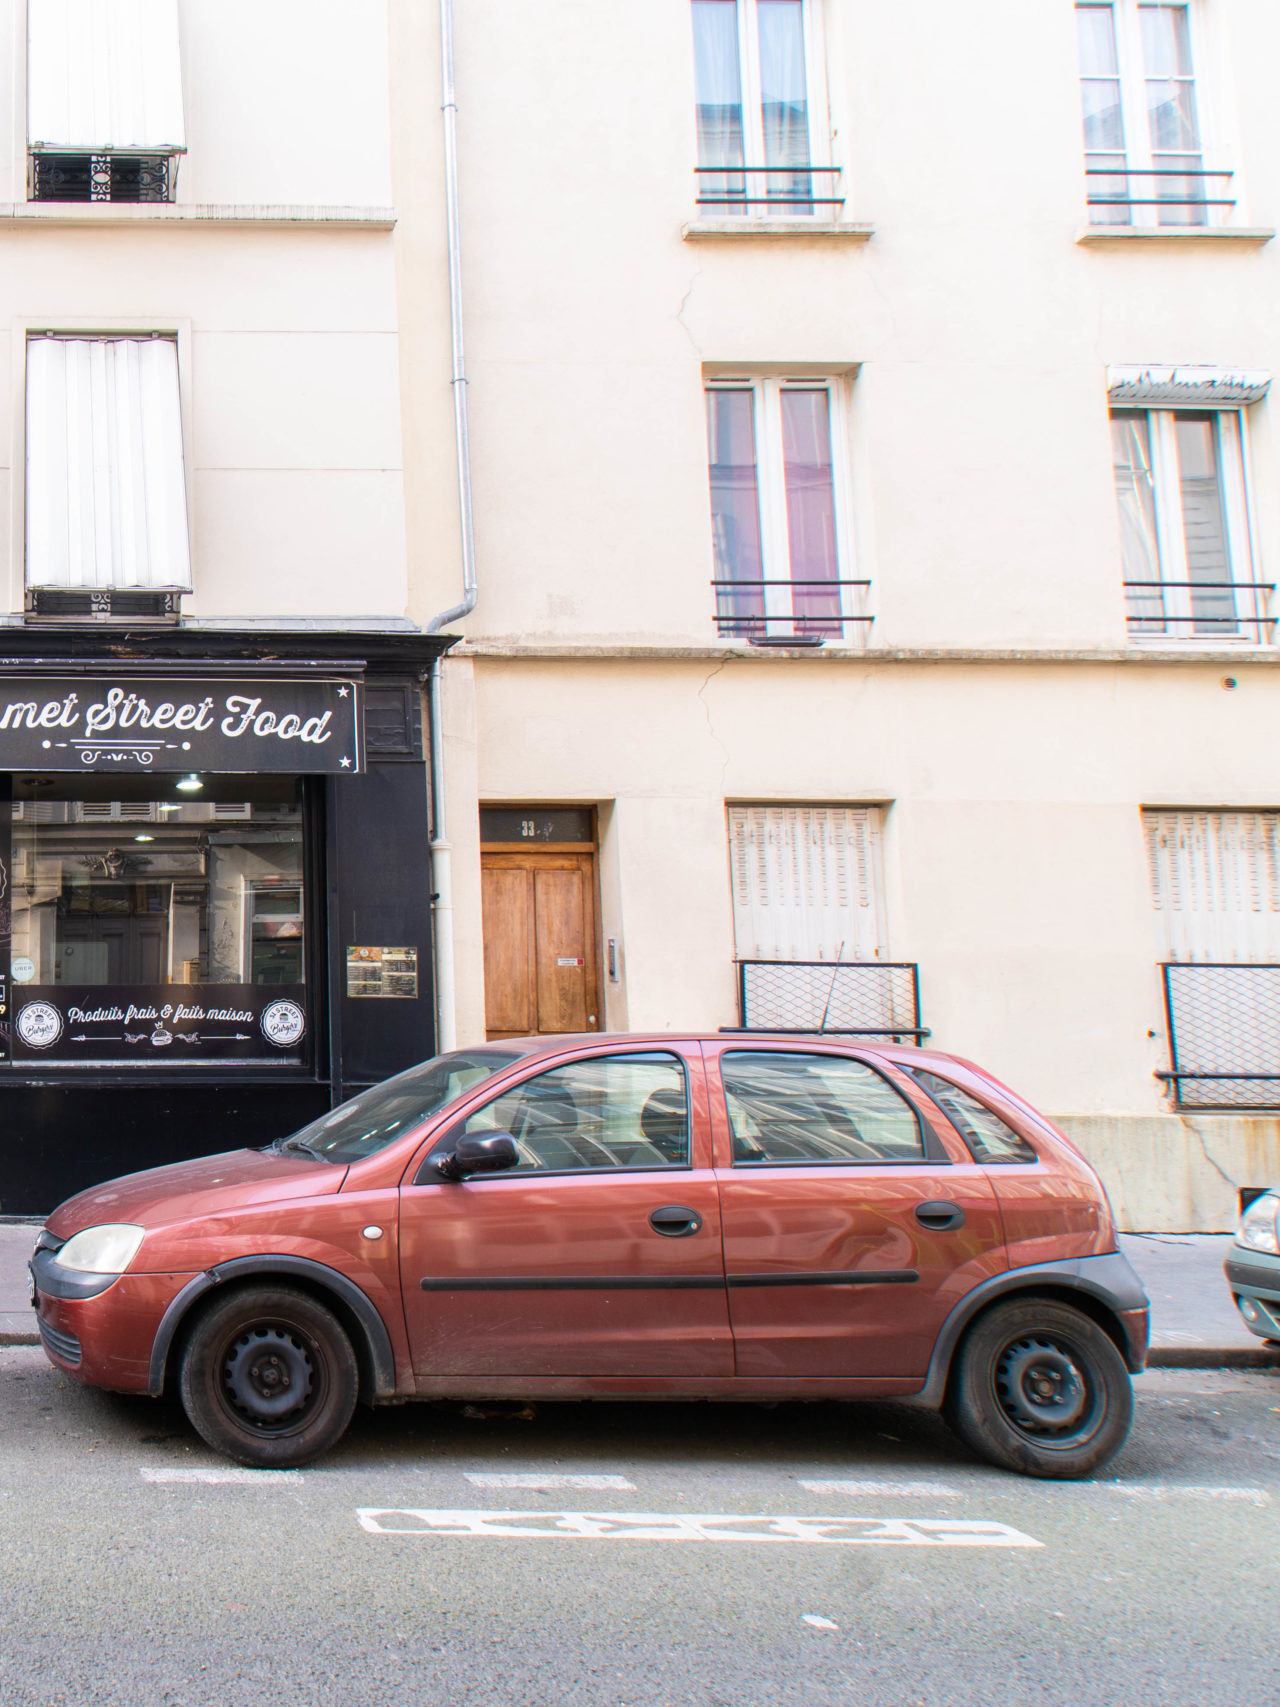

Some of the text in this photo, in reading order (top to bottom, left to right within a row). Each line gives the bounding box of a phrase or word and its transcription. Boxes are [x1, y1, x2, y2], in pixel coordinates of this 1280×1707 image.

[84, 687, 213, 737] Street
[220, 694, 332, 743] Food
[521, 820, 535, 837] 33
[31, 1007, 55, 1021] STREET
[67, 1004, 254, 1025] Produits frais & faits maison
[275, 1006, 299, 1019] STREET
